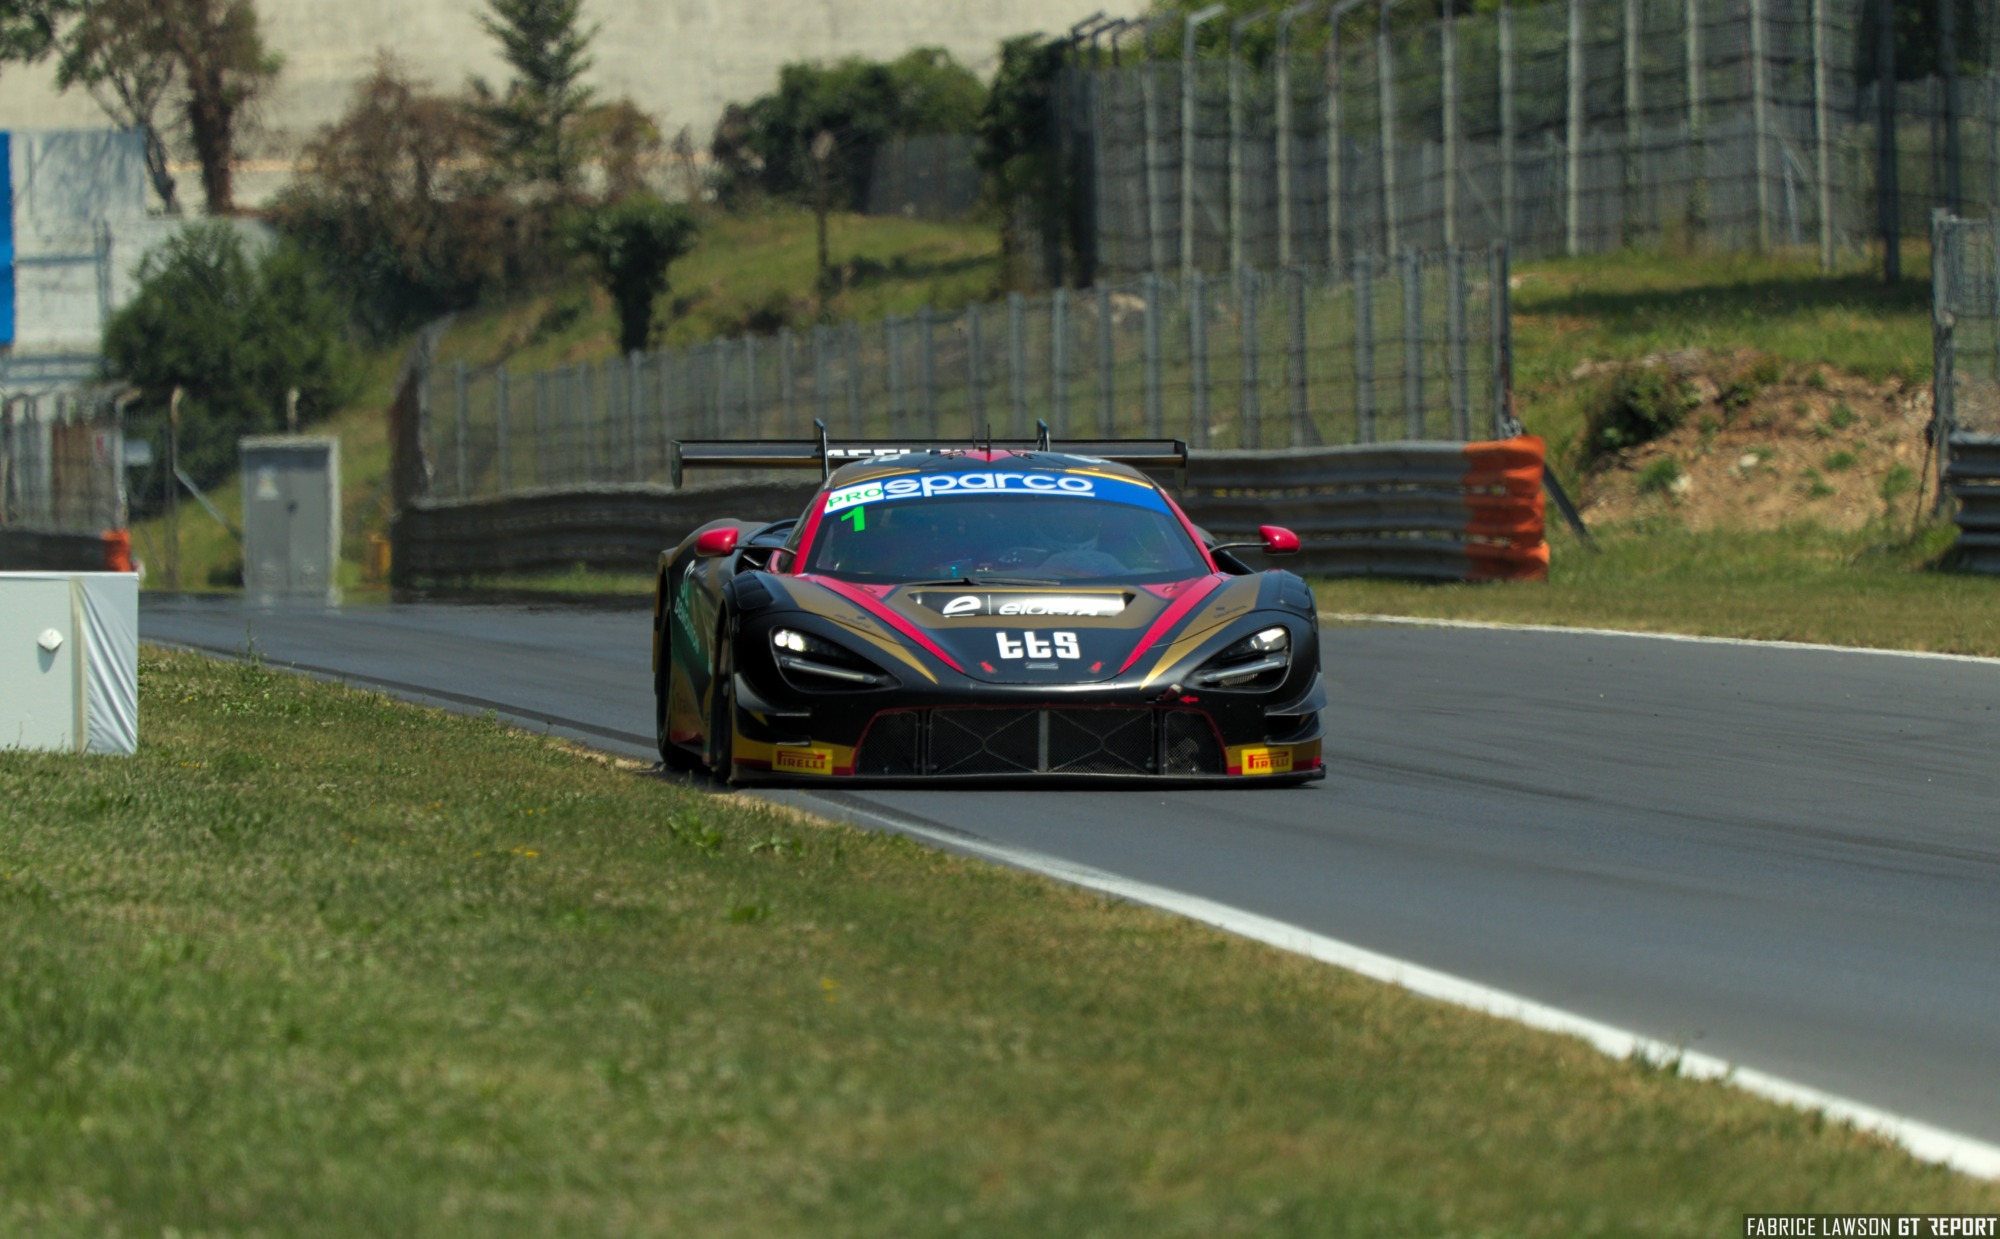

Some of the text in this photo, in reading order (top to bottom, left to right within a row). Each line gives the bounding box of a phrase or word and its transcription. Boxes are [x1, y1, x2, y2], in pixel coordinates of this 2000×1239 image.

[884, 473, 1094, 497] sparco
[828, 488, 882, 507] PRO
[841, 506, 865, 532] 1
[996, 631, 1080, 660] tts
[777, 751, 825, 769] PIRELLI
[1248, 752, 1288, 769] PIRELLI
